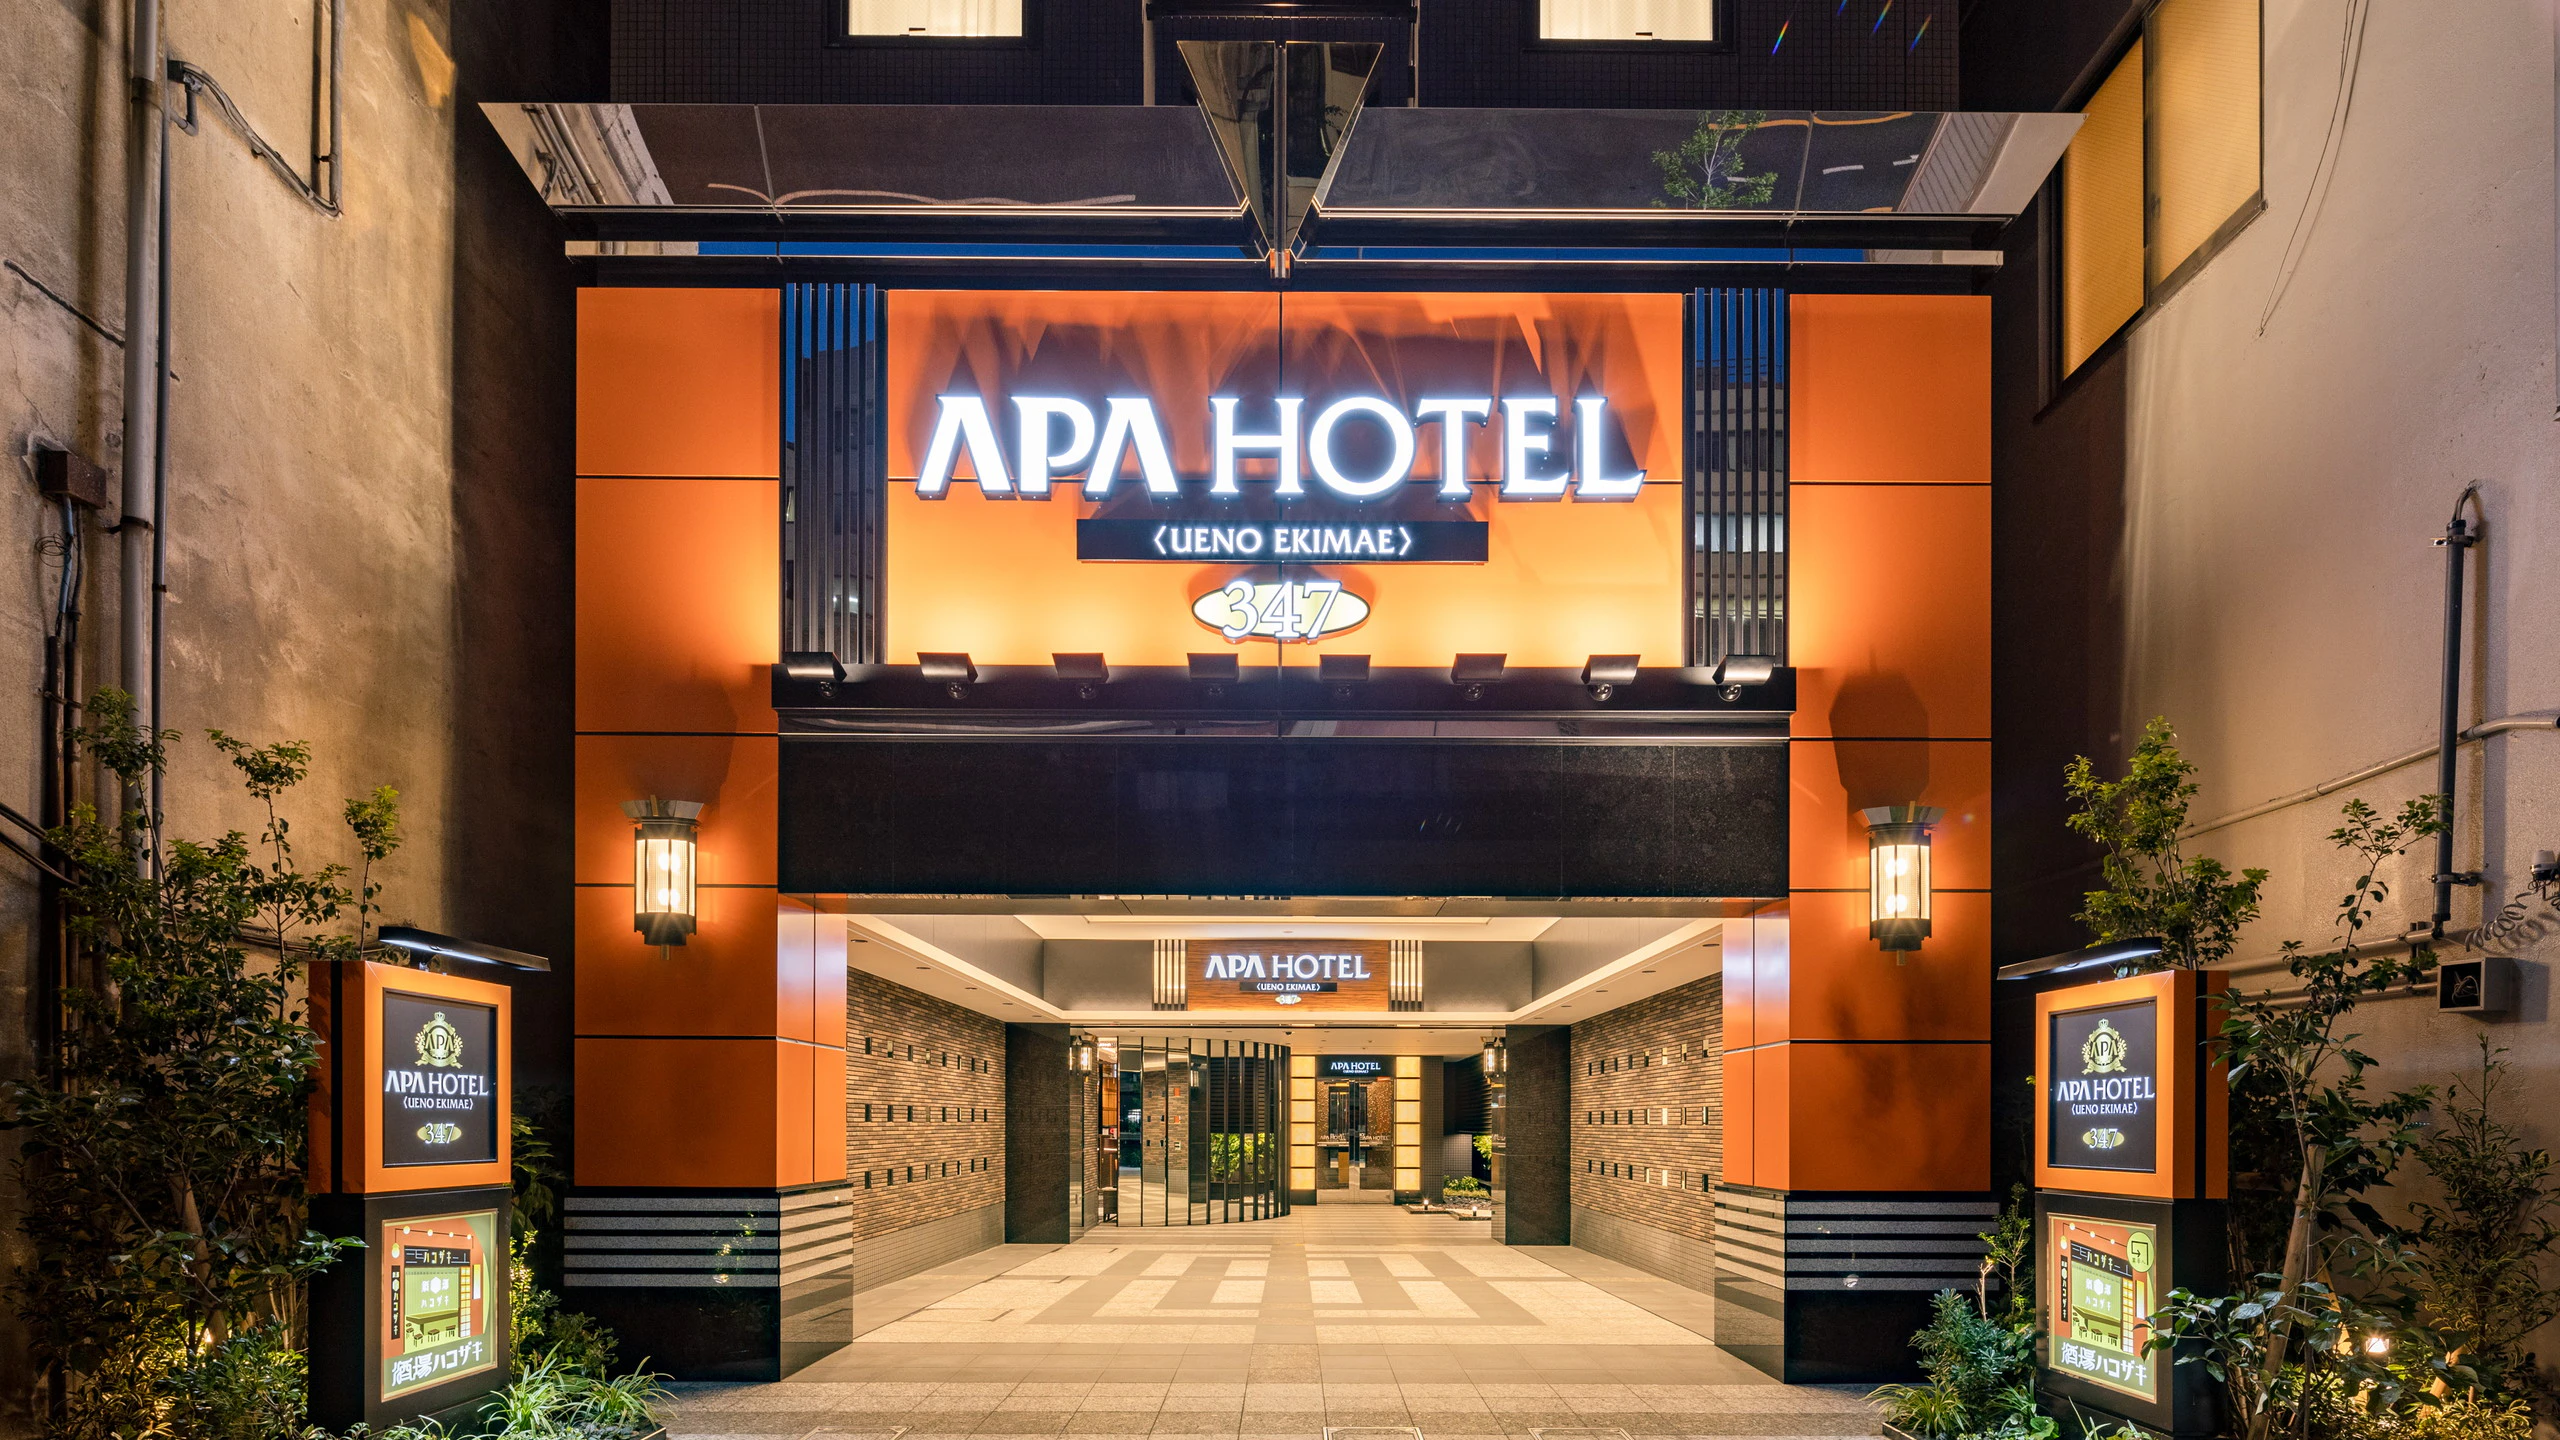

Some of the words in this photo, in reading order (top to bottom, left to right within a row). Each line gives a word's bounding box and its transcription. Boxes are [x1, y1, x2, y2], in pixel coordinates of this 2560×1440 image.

[916, 394, 1182, 499] APA
[1208, 395, 1646, 502] HOTEL
[1221, 580, 1343, 640] 347
[1205, 955, 1266, 980] APA
[1272, 955, 1371, 980] HOTEL
[1331, 1062, 1349, 1070] APA
[1351, 1062, 1381, 1070] HOTEL
[385, 1070, 426, 1093] APA
[428, 1073, 489, 1096] HOTEL
[2057, 1080, 2091, 1101] APA
[2093, 1077, 2155, 1100] HOTEL
[425, 1122, 455, 1144] 347
[2089, 1128, 2118, 1149] 347
[391, 1341, 483, 1387] 酒場ハコザキ
[2061, 1342, 2147, 1387] 酒場ハコザキ
